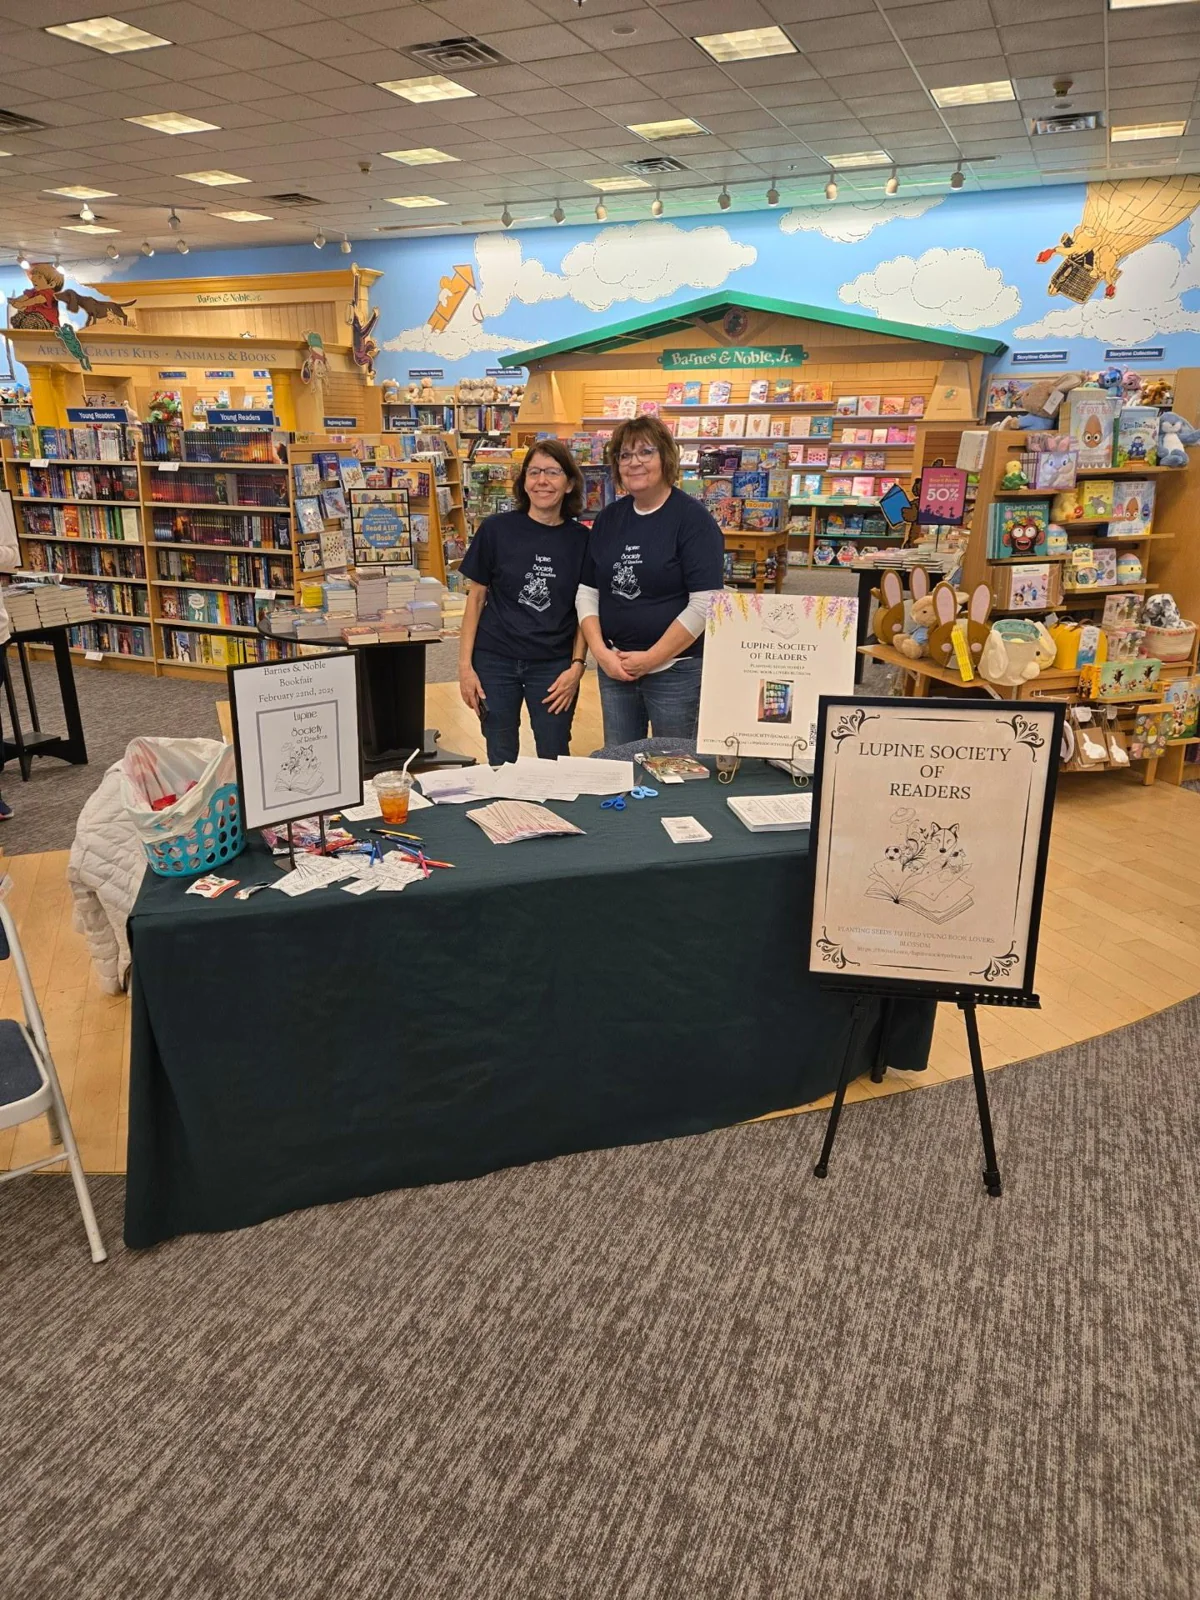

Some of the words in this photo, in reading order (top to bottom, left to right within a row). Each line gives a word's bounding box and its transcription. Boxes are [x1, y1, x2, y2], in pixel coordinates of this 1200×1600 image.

[196, 294, 222, 304] Barnes
[222, 293, 230, 302] &
[37, 344, 68, 356] ARTS
[84, 345, 129, 357] CRAFTS
[132, 347, 160, 359] KITS
[174, 349, 226, 361] ANIMALS
[227, 351, 238, 361] &
[239, 350, 277, 362] BOOKS
[671, 351, 717, 366] Barnes
[718, 350, 732, 365] &
[733, 350, 775, 366] Noble,
[776, 347, 794, 364] Jr.
[78, 412, 95, 420] Young
[95, 412, 116, 420] Readers
[220, 413, 238, 423] Young
[238, 413, 261, 421] Readers
[926, 487, 959, 501] 50%
[263, 666, 291, 676] Barnes
[292, 664, 301, 673] &
[302, 661, 326, 671] Noble
[279, 676, 313, 688] Bookfair
[259, 690, 294, 703] February
[295, 687, 317, 698] 22nd,
[318, 686, 334, 695] 2025
[858, 742, 925, 758] LUPINE
[929, 744, 1012, 762] SOCIETY
[919, 764, 945, 779] OF
[889, 782, 971, 800] READERS
[837, 926, 871, 935] PLANTING
[871, 927, 892, 935] SEEDS
[893, 929, 903, 937] TO
[904, 930, 922, 938] HELP
[922, 932, 947, 940] YOUNG
[899, 940, 931, 949] BLOSSOM
